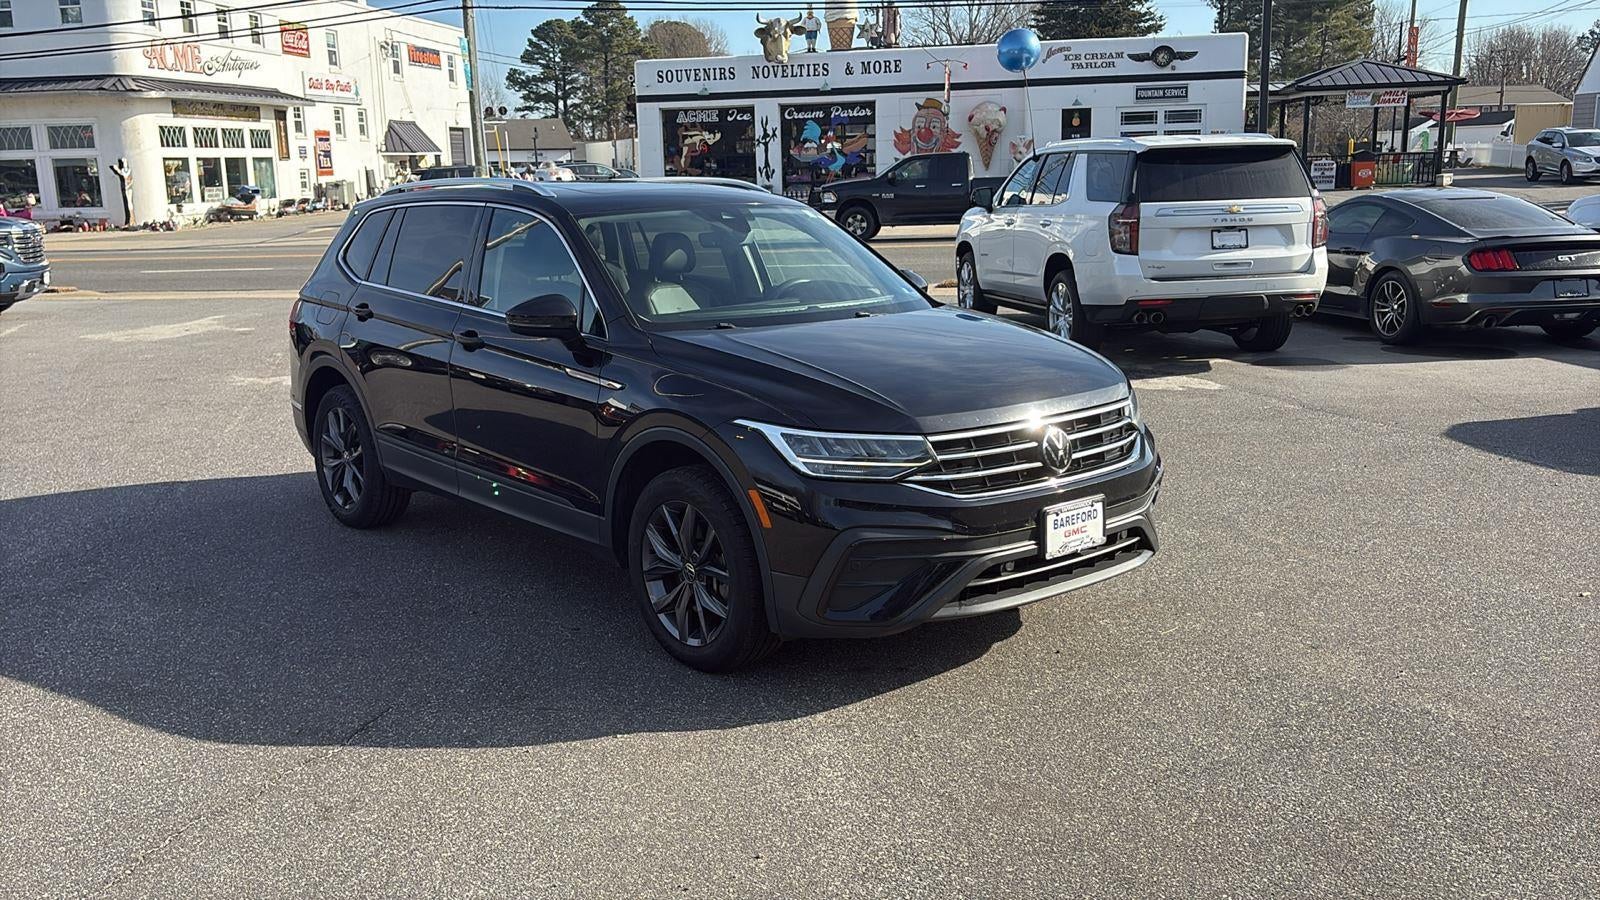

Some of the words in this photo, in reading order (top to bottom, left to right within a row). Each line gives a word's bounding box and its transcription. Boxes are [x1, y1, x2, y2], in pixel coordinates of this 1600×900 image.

[142, 39, 204, 74] ACME
[203, 50, 261, 78] Antiques
[408, 45, 441, 66] Firestone
[1084, 51, 1124, 60] CREAM
[656, 66, 736, 84] SOUVENIRS
[751, 62, 830, 79] NOVELTIES
[844, 61, 855, 76] &
[860, 59, 902, 75] MORE
[1070, 61, 1116, 70] PARLOR
[308, 77, 324, 89] Dutch
[325, 79, 335, 93] Boy
[1137, 89, 1163, 98] FOUNTAIN
[1164, 87, 1187, 97] SERVICE
[676, 110, 719, 123] ACME
[726, 109, 752, 122] Ice
[784, 107, 825, 120] Cream
[830, 105, 872, 118] Parlor
[1557, 254, 1577, 263] GT
[1053, 509, 1098, 530] BAREFORD
[1064, 525, 1088, 538] GMC
